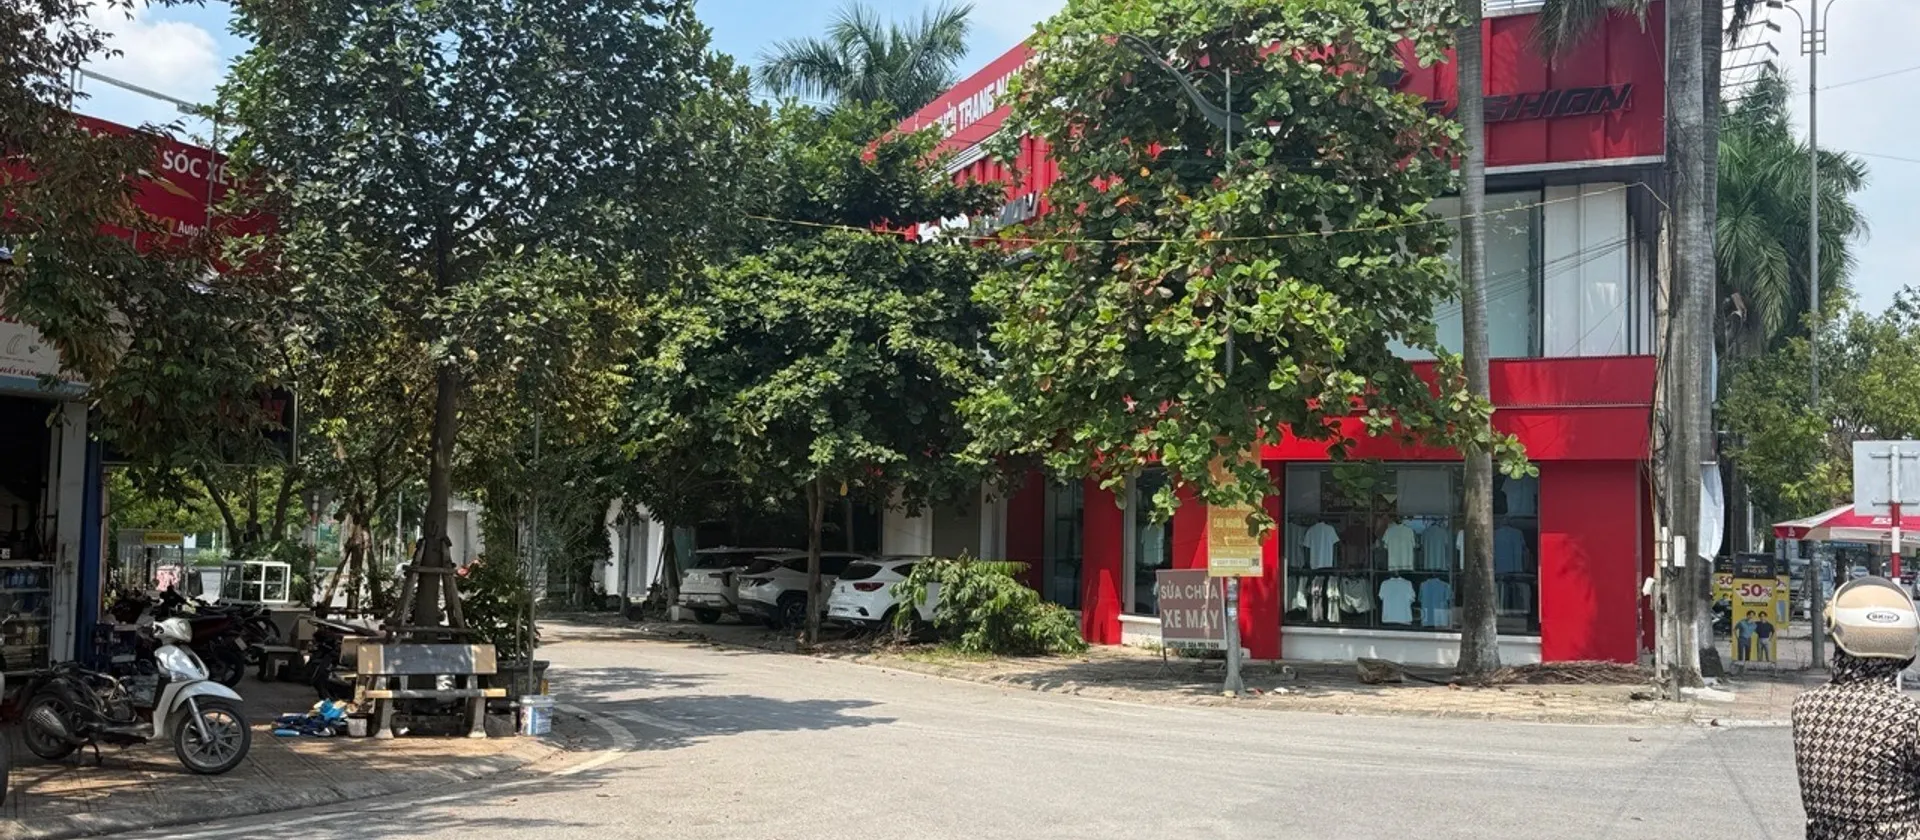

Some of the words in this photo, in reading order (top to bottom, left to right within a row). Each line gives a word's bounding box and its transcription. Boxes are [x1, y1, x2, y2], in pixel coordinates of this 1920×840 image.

[959, 82, 995, 131] TRANG
[162, 149, 202, 178] SÓC
[178, 220, 199, 237] Auto
[1161, 580, 1182, 600] SỬA
[1736, 584, 1773, 598] -50%
[1163, 609, 1181, 628] XE
[1185, 604, 1219, 629] MÁY
